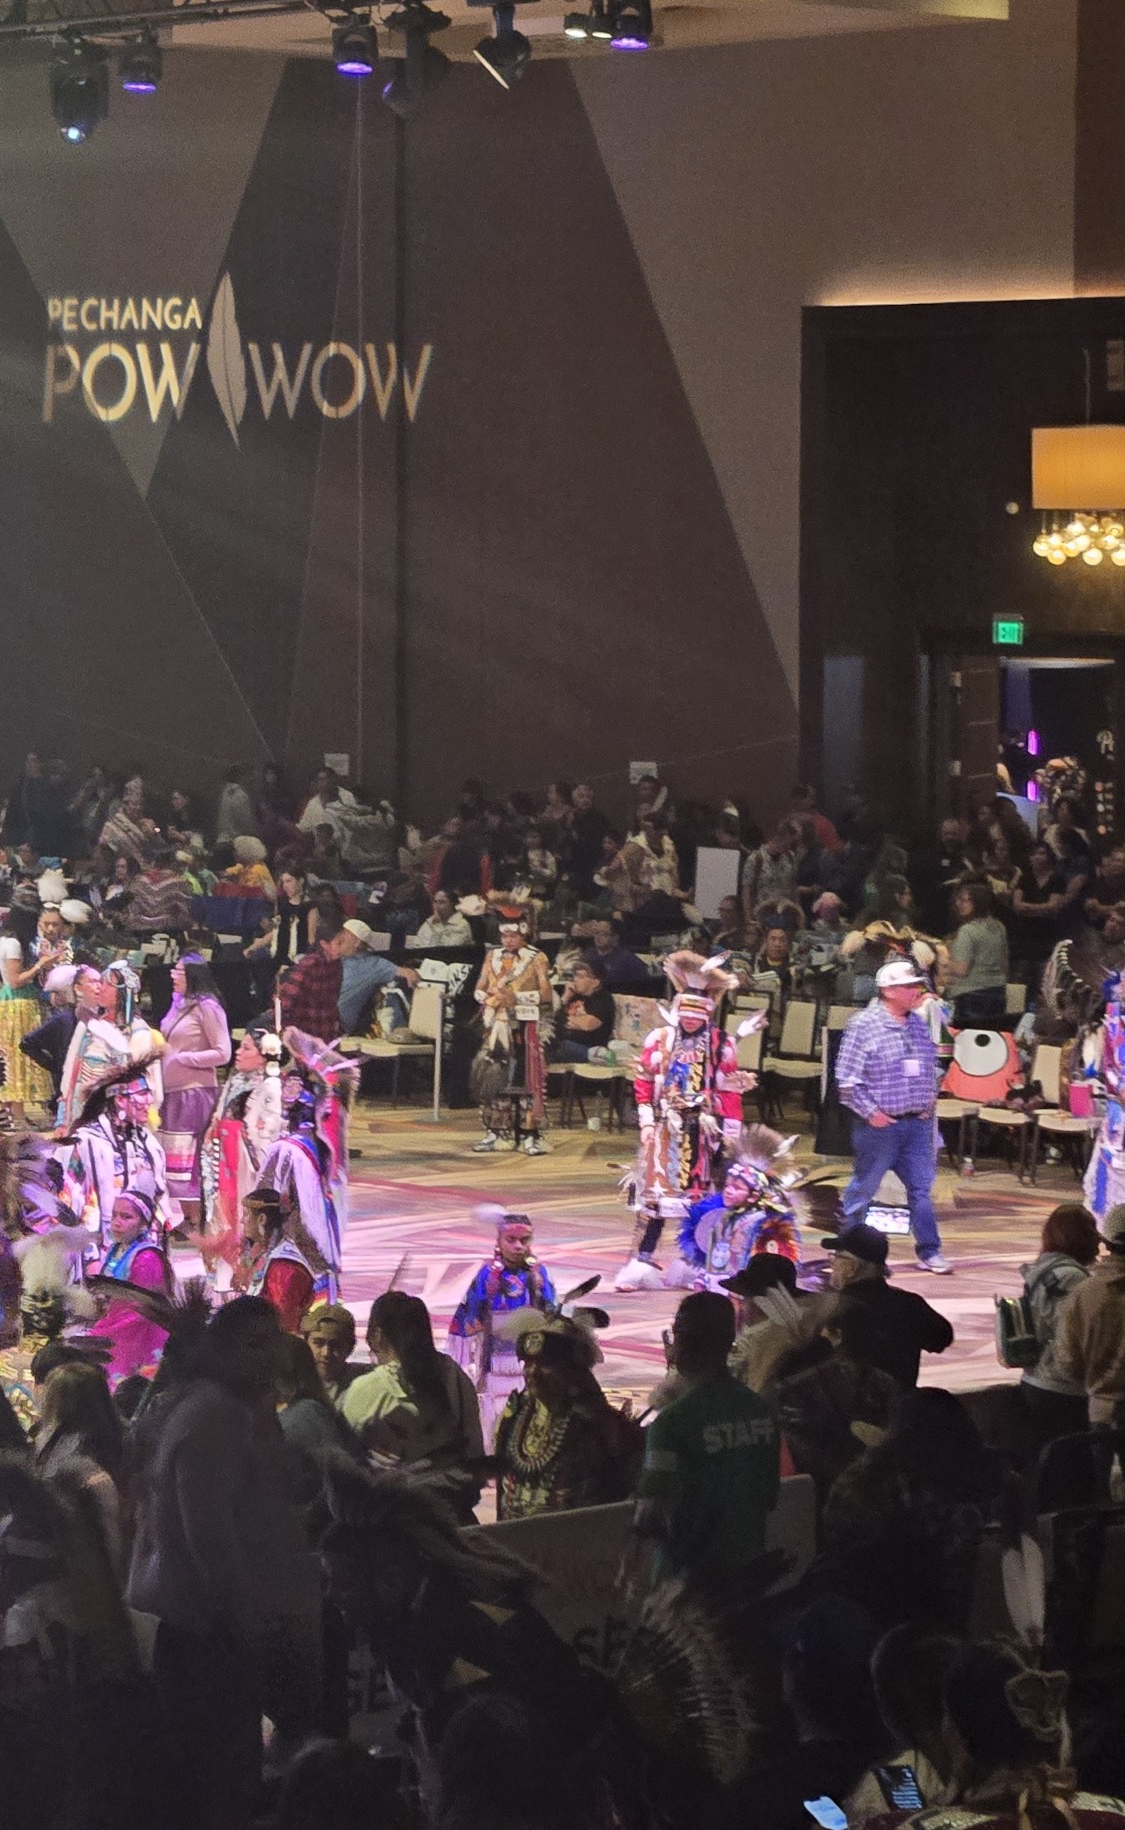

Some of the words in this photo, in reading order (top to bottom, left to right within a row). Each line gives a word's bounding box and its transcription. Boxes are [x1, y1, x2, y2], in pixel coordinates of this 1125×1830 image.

[47, 297, 203, 331] PECHANGA
[42, 341, 201, 423] POW
[248, 341, 434, 423] WOW
[702, 1417, 774, 1454] STAFF
